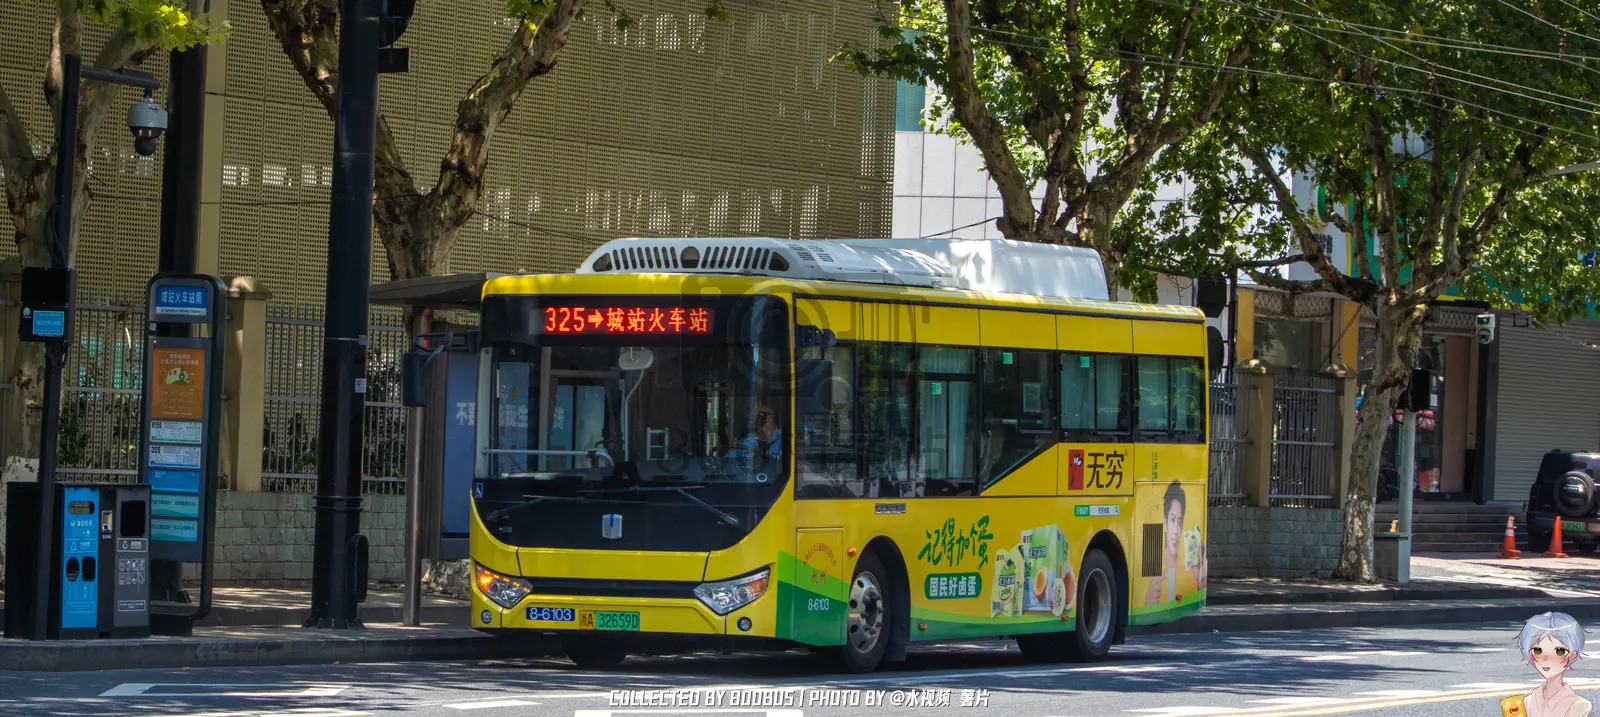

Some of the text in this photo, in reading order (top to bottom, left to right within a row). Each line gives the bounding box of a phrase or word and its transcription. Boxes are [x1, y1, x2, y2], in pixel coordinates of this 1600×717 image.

[545, 306, 709, 333] 325 城站火车站
[1086, 450, 1125, 489] 无穷
[929, 575, 977, 597] 国民好卤蛋
[529, 607, 572, 620] 8-6103
[808, 598, 830, 611] 8-6103
